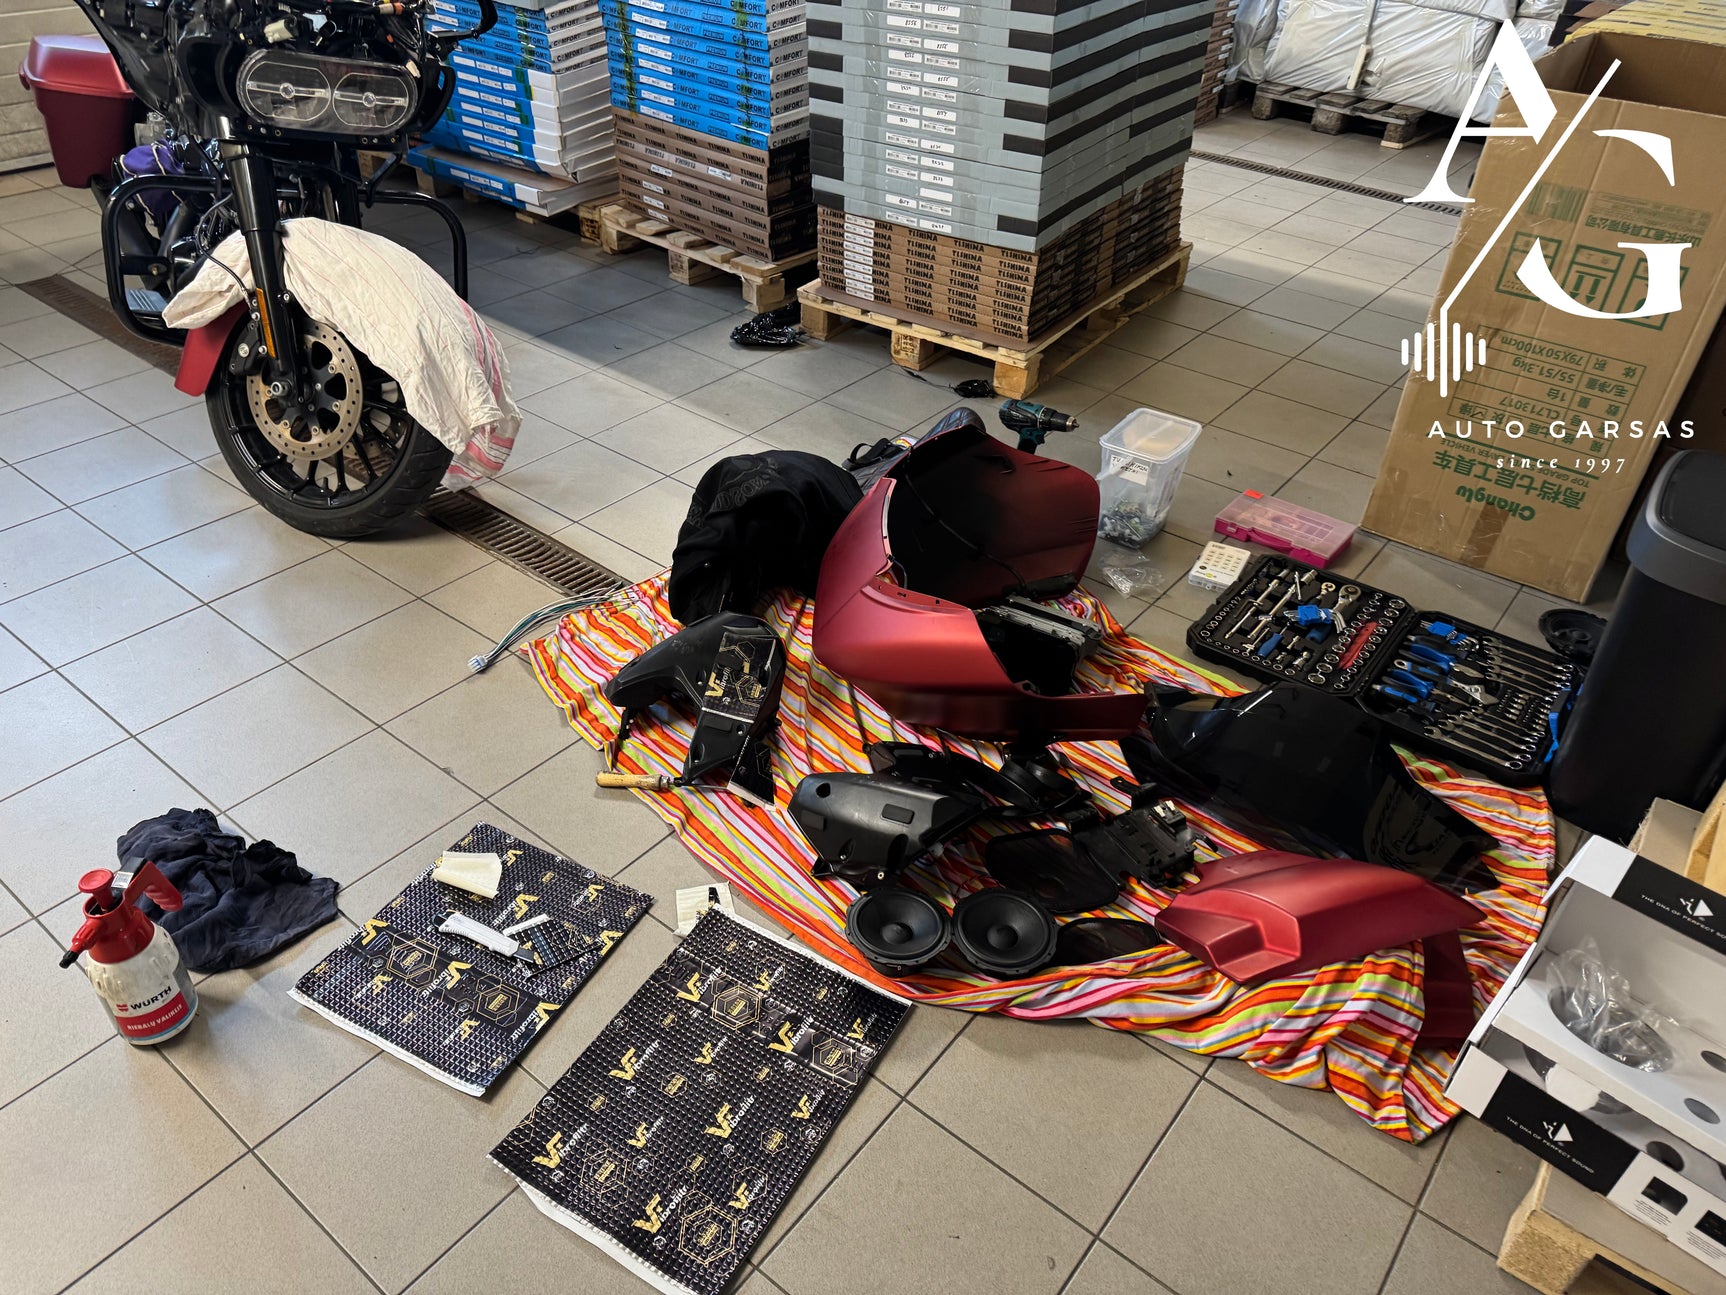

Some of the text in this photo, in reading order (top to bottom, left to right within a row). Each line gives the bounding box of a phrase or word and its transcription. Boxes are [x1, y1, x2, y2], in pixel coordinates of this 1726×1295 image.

[1499, 397, 1561, 420] CL713017
[1432, 450, 1587, 511] 高档七层工具车
[1571, 478, 1590, 490] TOP
